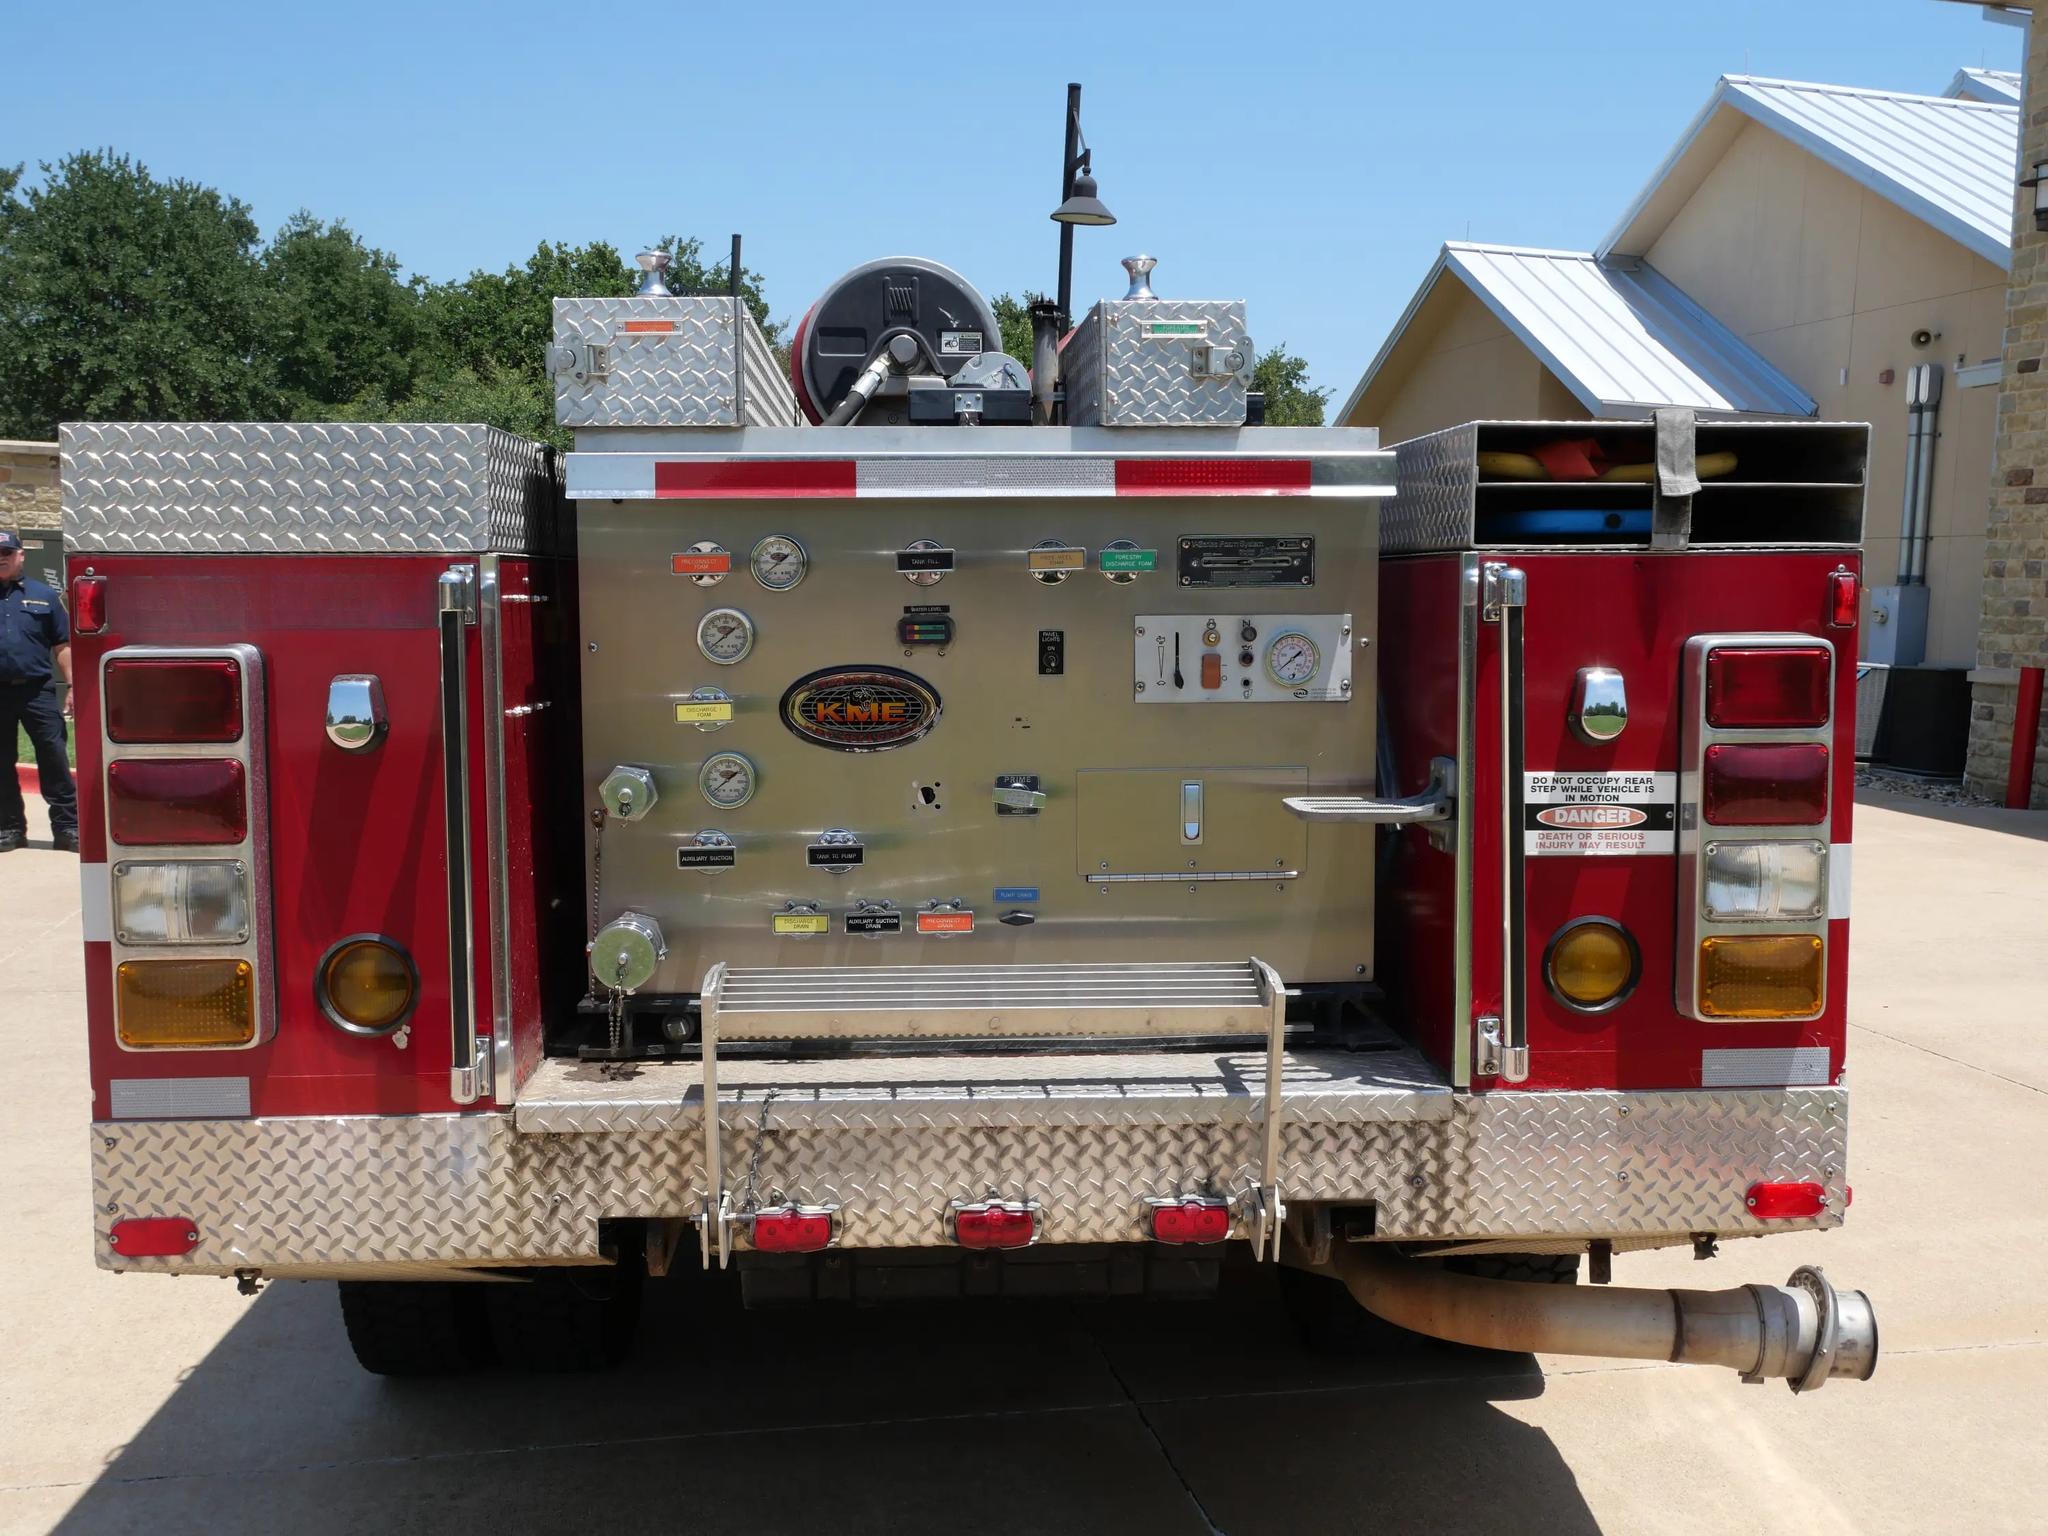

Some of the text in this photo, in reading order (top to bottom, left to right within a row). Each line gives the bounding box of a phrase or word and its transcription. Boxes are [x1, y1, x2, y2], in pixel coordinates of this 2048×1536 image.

[816, 702, 906, 722] KME
[1532, 777, 1653, 785] DO NOT OCCUPY REAR
[1530, 785, 1655, 793] STEP WHILE VEHICLE IS
[1565, 794, 1620, 802] IN MOTION
[1554, 809, 1631, 824] DANGER
[1537, 832, 1645, 840] DEATH OR SERIOUS
[1535, 841, 1646, 849] INJURY MAY RESULT
